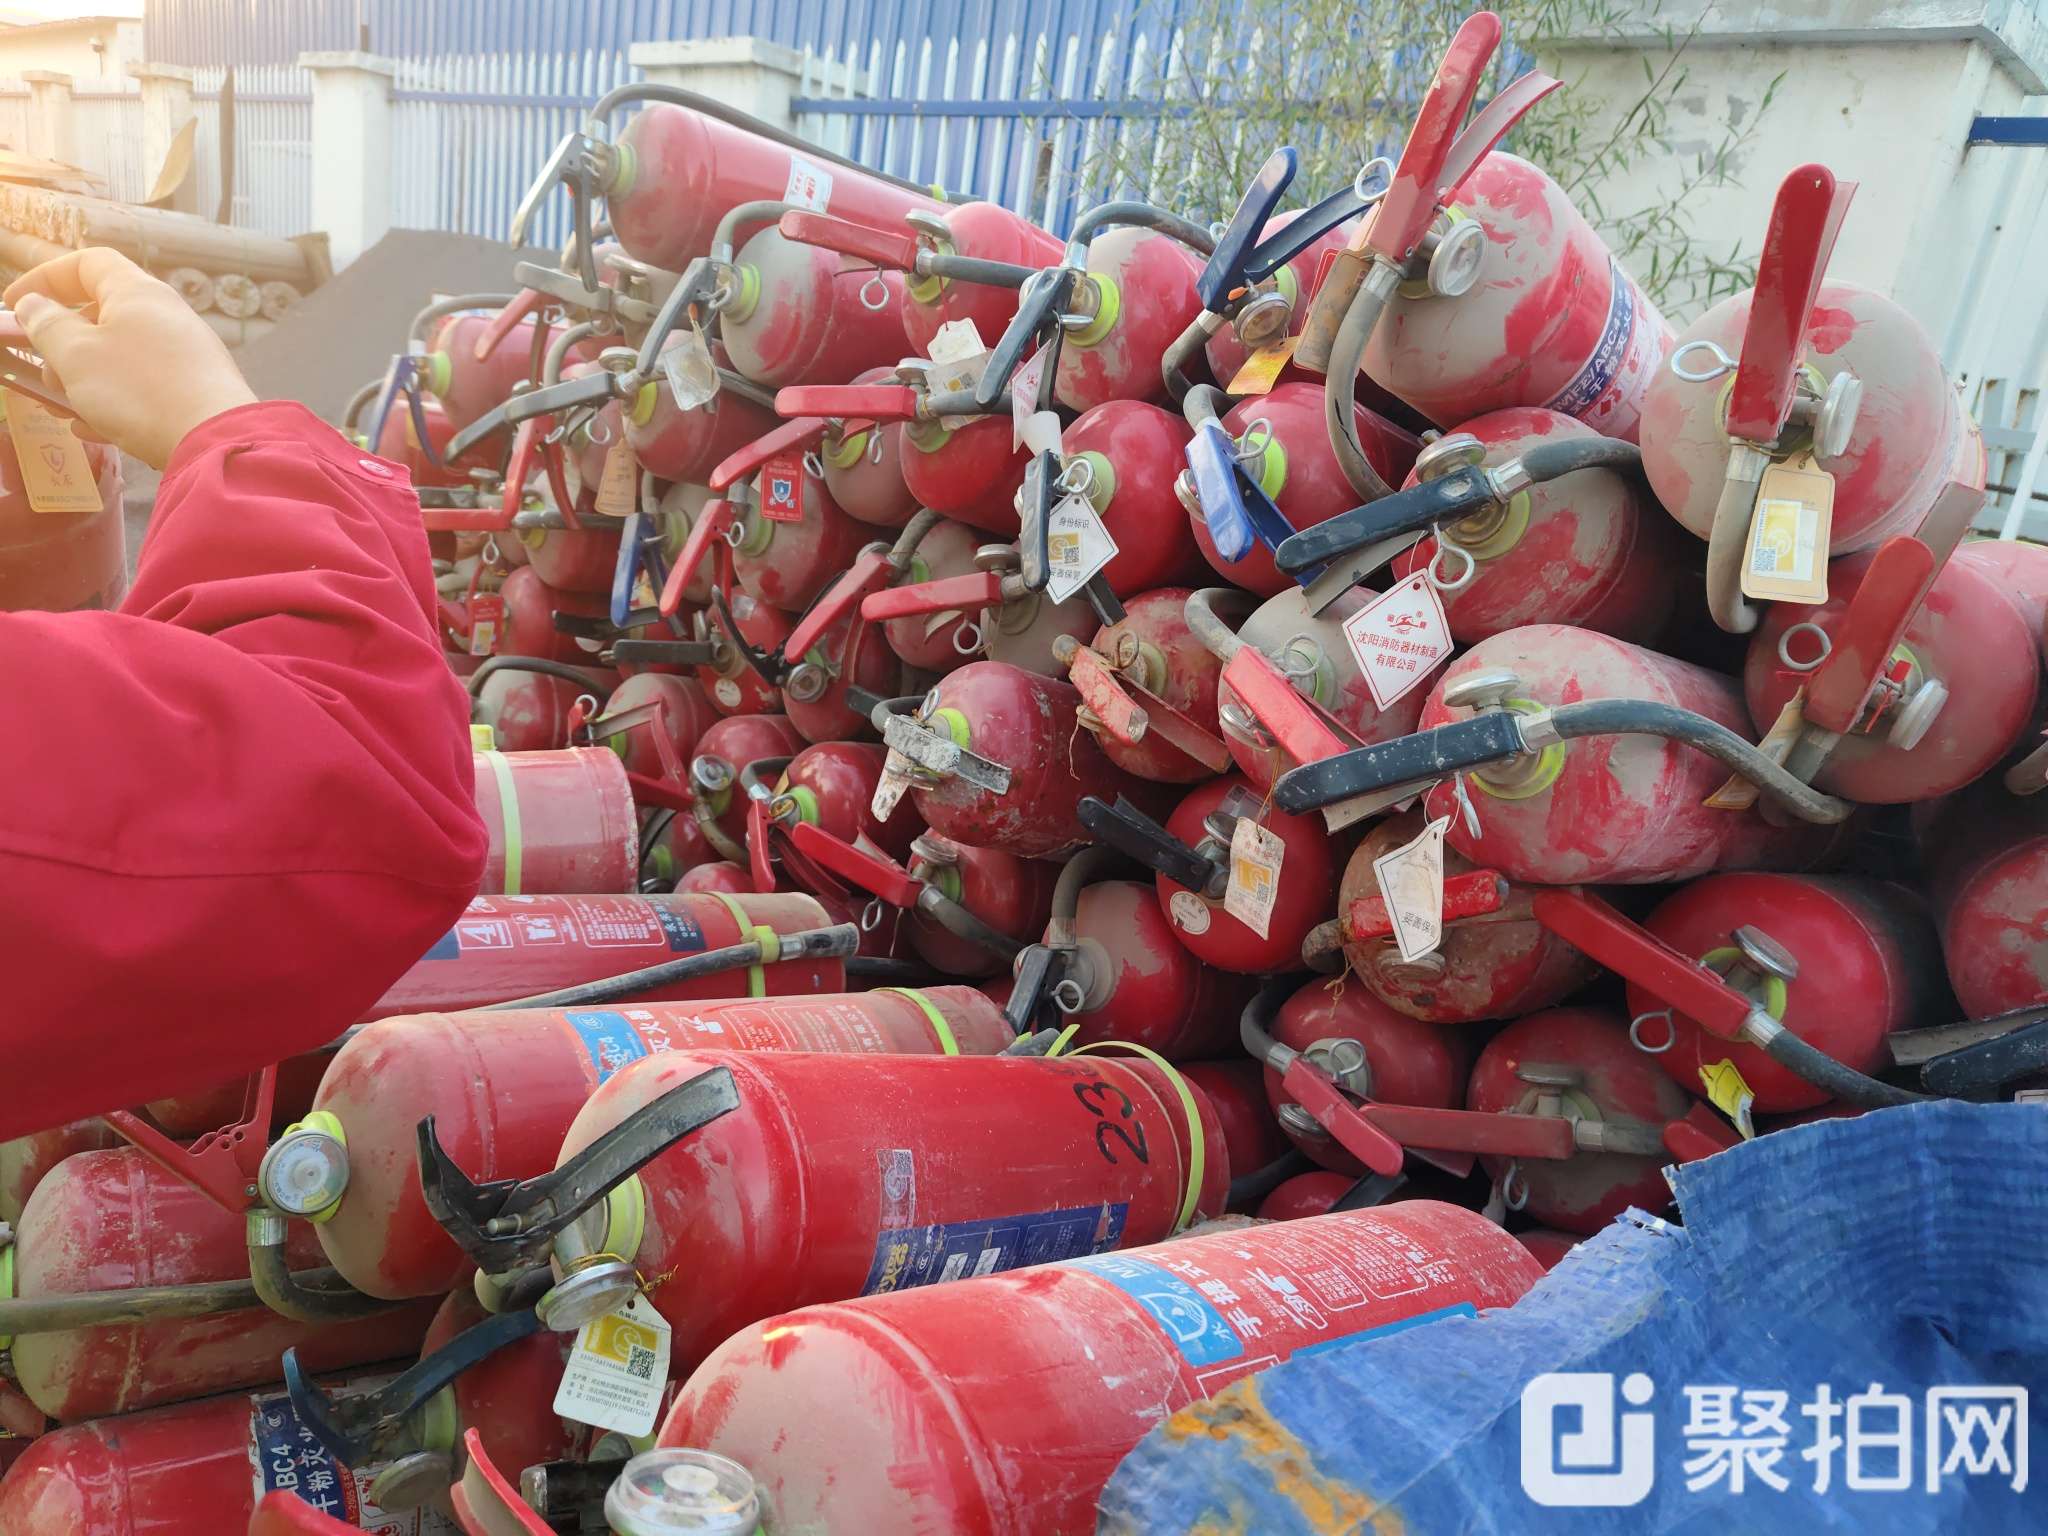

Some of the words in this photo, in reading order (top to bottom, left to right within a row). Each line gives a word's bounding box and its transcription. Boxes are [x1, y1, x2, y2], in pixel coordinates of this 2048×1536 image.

[1058, 516, 1090, 529] 身份标识
[1356, 631, 1438, 659] 沈阳消防器材制造
[1375, 653, 1417, 673] 有限公司
[1401, 911, 1435, 936] 妥善保
[1073, 1081, 1148, 1166] 23
[271, 1443, 300, 1492] BC4
